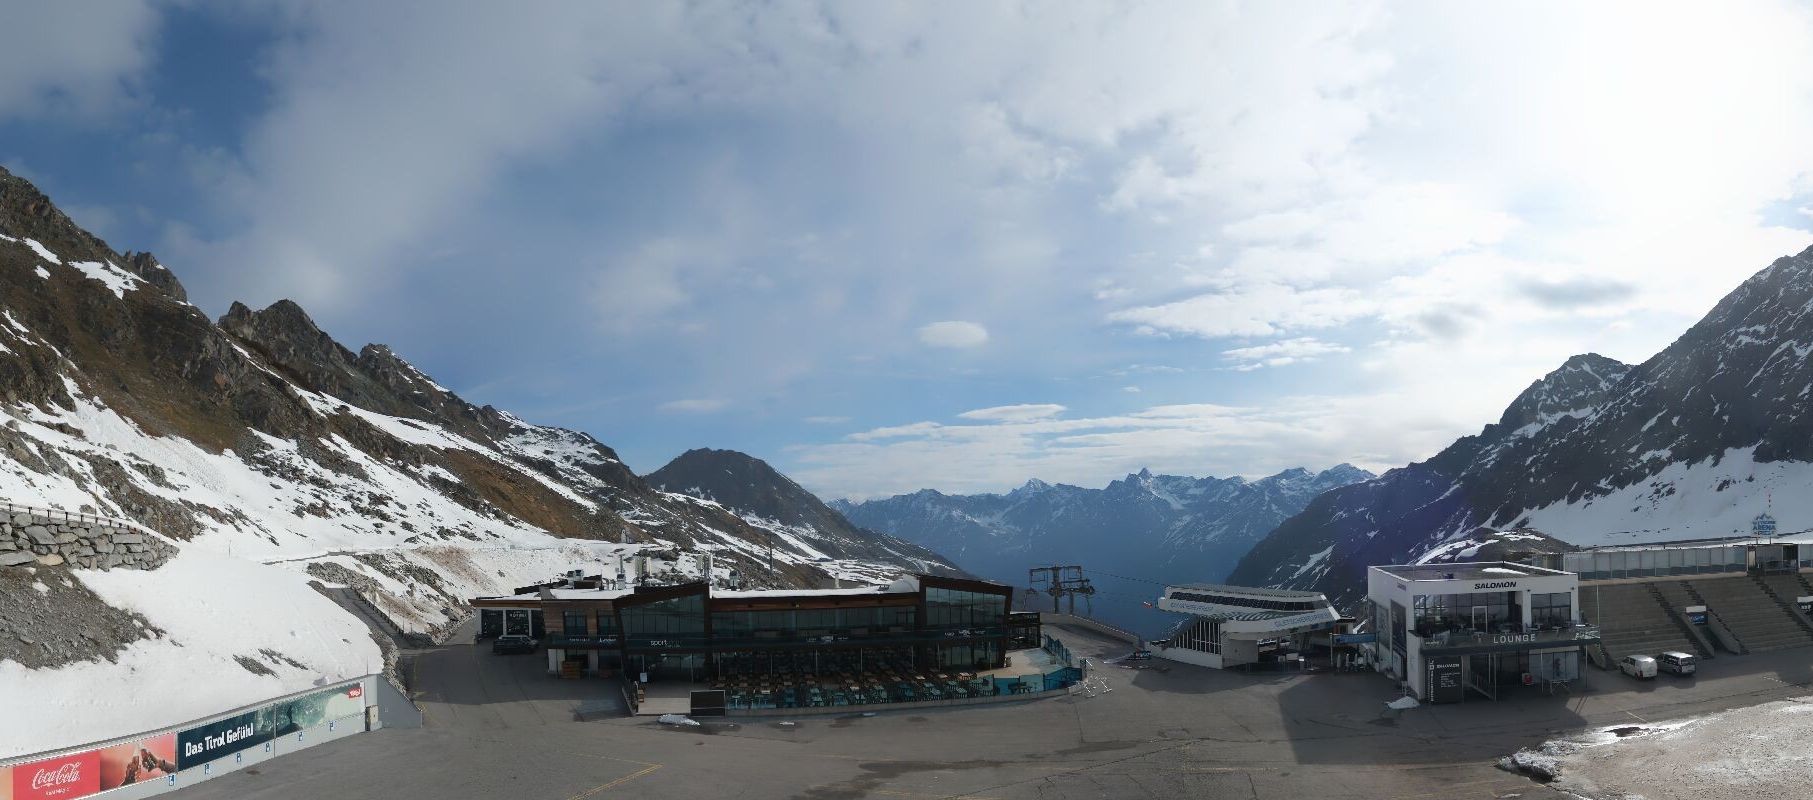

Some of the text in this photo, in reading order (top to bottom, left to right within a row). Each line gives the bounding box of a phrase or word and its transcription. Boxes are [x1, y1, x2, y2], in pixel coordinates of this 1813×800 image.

[1474, 581, 1517, 590] SALOMON
[1493, 633, 1536, 644] LOUNGE
[185, 722, 254, 757] Das Tirol Gefühl
